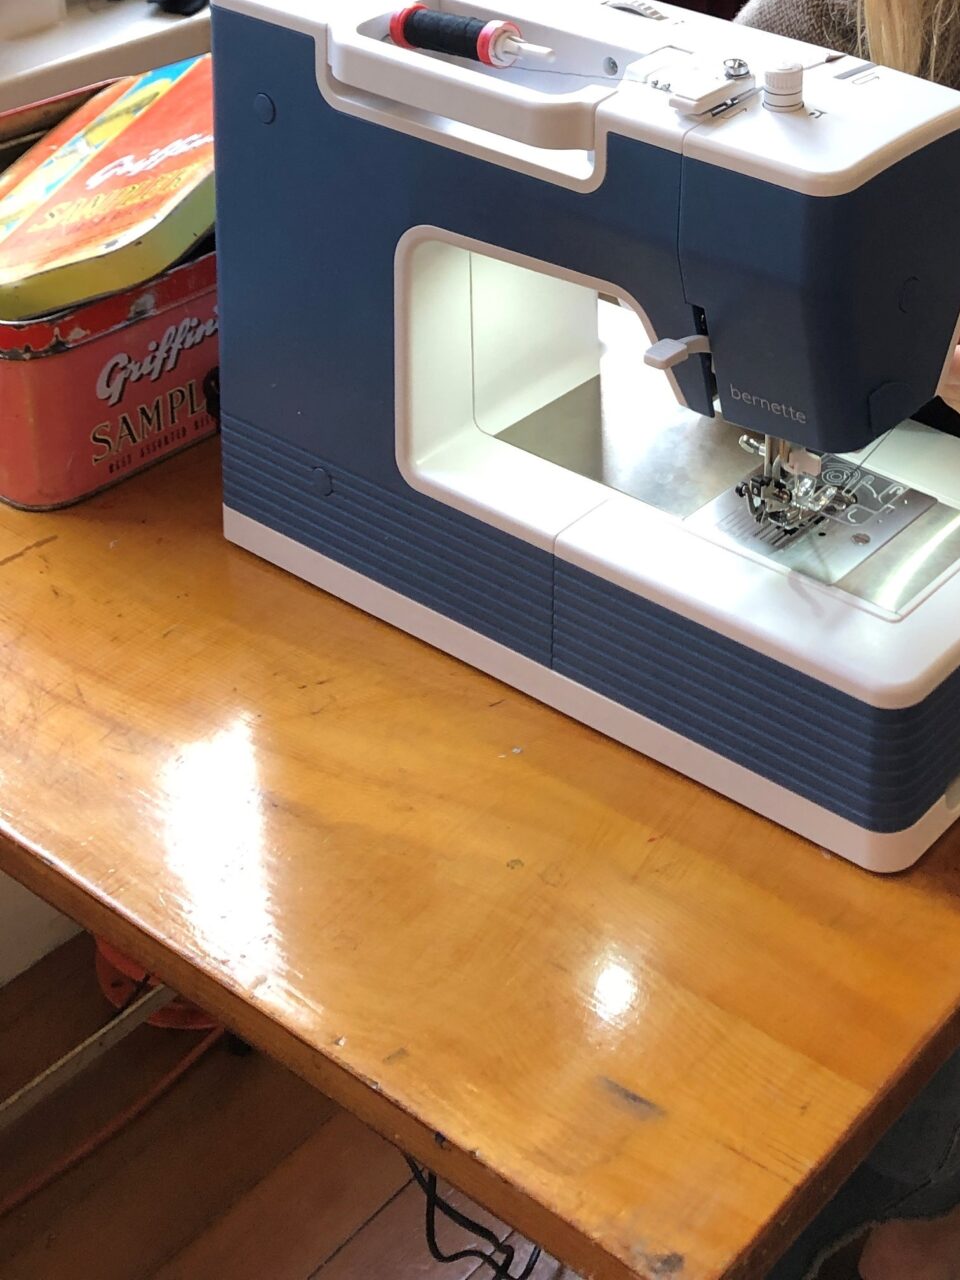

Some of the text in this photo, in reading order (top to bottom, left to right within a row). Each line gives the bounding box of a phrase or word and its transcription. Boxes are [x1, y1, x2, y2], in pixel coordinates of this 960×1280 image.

[96, 306, 219, 407] Griffin
[90, 380, 206, 465] SAMPL
[730, 384, 807, 423] bernette
